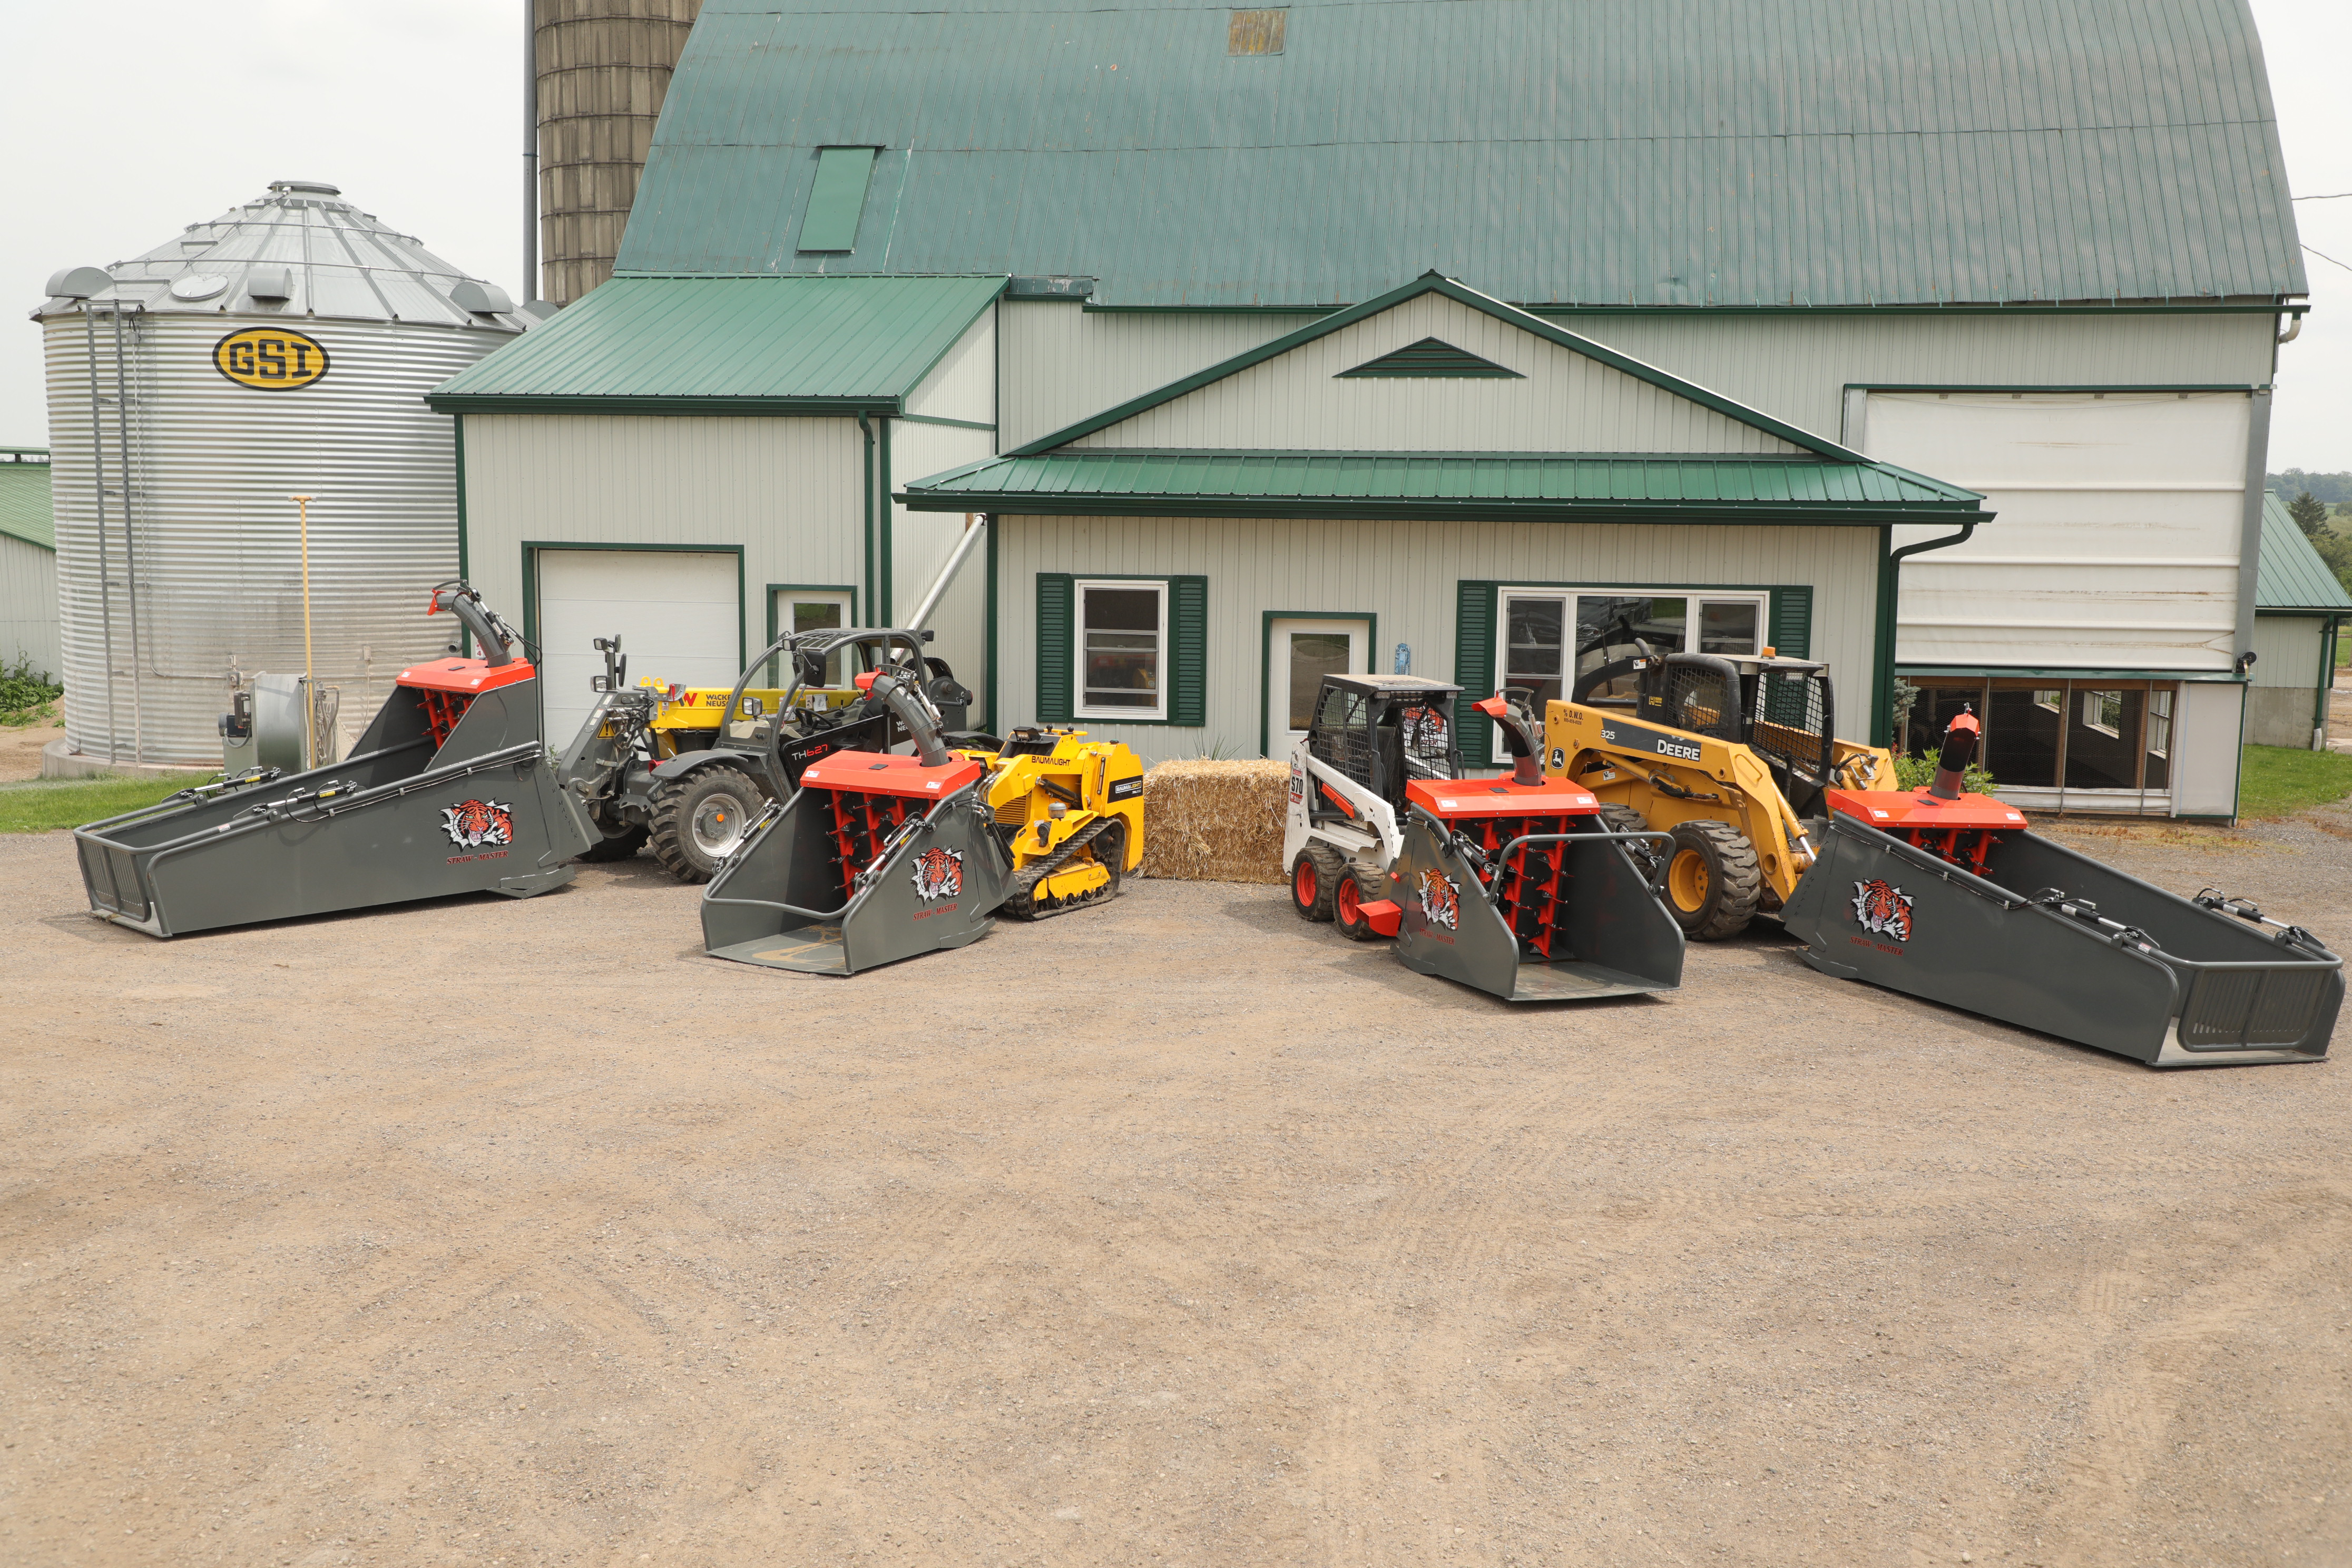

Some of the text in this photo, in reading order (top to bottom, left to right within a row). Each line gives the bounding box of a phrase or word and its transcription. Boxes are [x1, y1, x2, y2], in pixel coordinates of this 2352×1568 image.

[229, 339, 312, 379] GSI
[1601, 730, 1615, 740] 325
[791, 744, 828, 761] TH627
[1657, 739, 1700, 761] DEERE
[1032, 756, 1071, 766] BAUMALIGHT
[1116, 782, 1141, 791] BAUMALIGHT
[1291, 776, 1304, 795] S70
[446, 855, 474, 865] STRAW
[478, 850, 508, 860] MASTER
[913, 909, 933, 921] STRAW
[936, 903, 958, 915] MASTER
[1419, 928, 1434, 939] STRAW
[1436, 933, 1456, 946] MASTER
[1849, 936, 1873, 948] STRAW
[1876, 943, 1904, 956] MASTER
